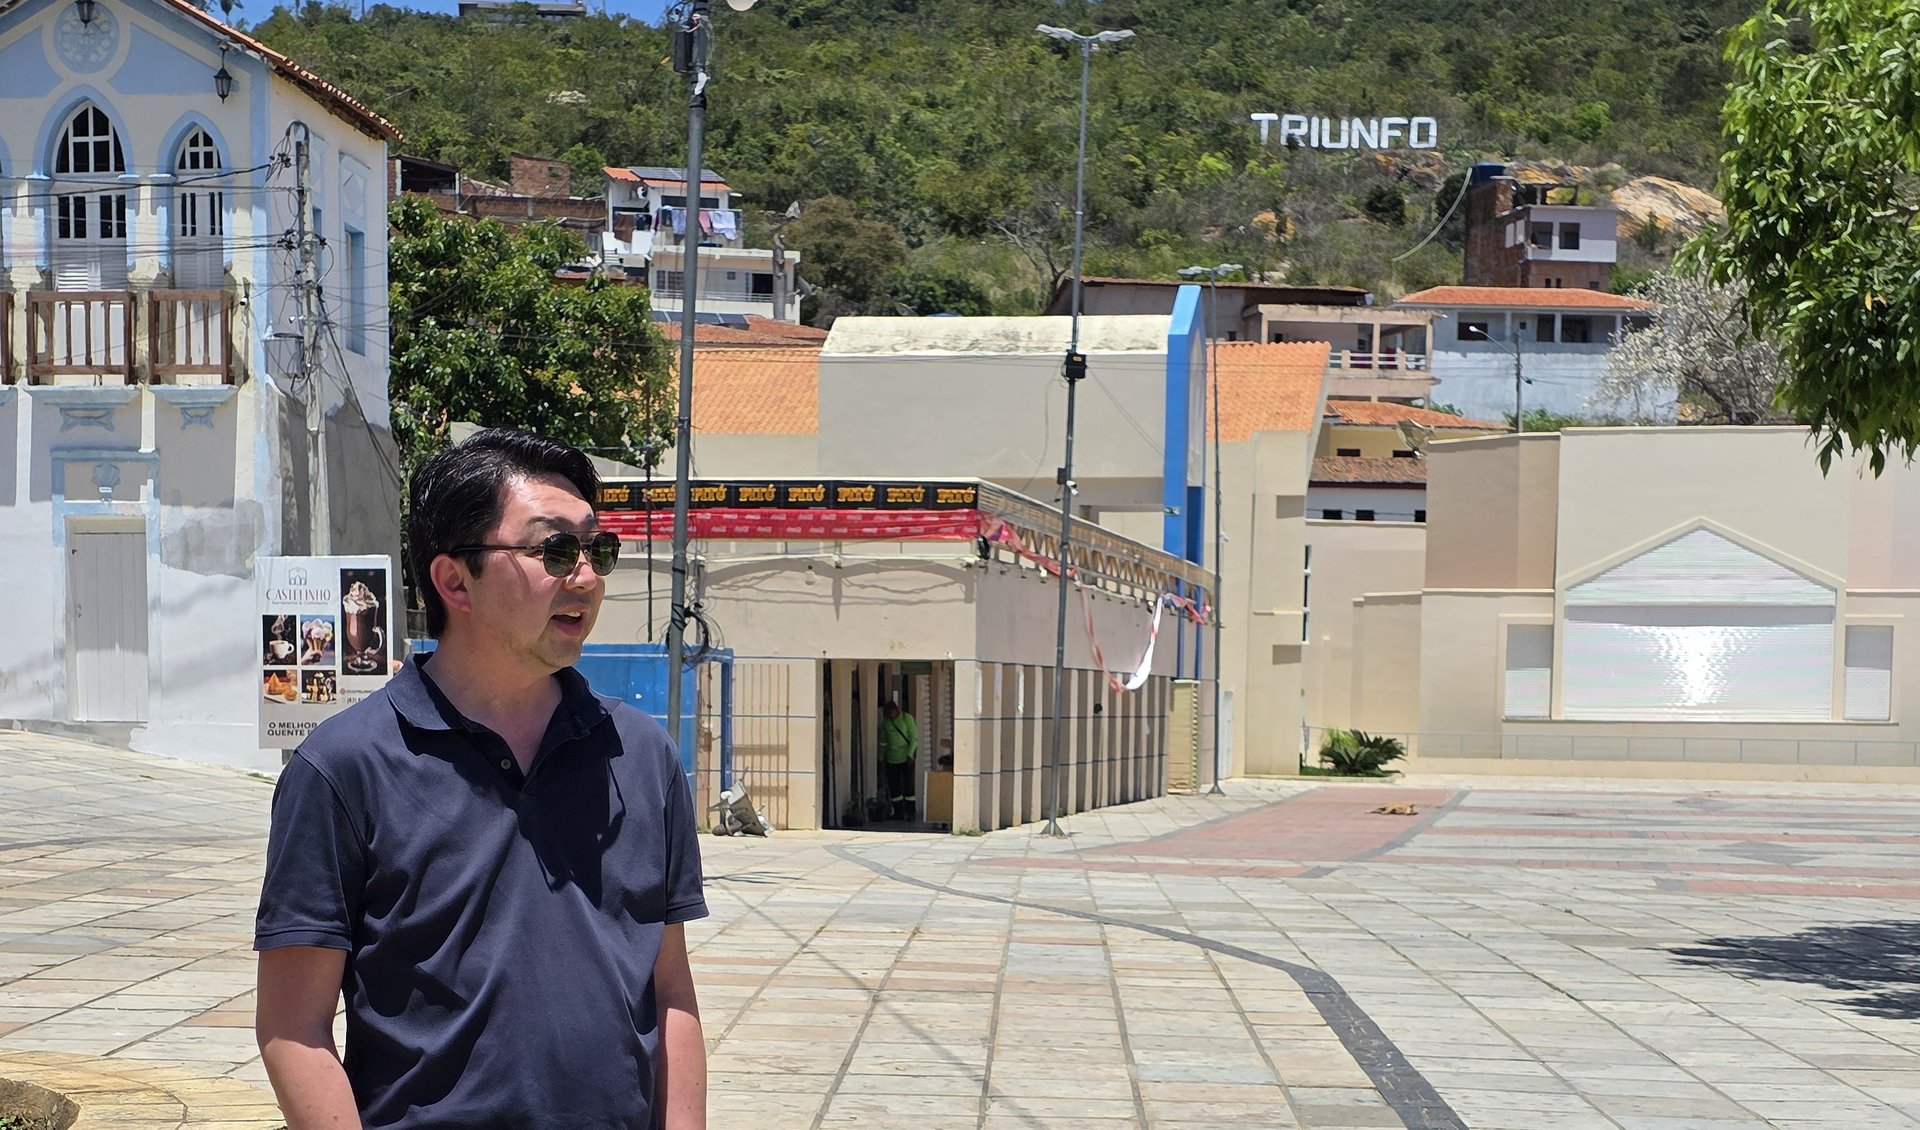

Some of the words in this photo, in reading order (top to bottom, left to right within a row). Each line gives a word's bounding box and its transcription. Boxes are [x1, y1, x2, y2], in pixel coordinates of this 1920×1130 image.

[1250, 113, 1438, 149] TRIUNFO
[690, 484, 728, 502] PITÚ
[739, 484, 776, 502] PITÚ
[788, 484, 825, 502] PITÚ
[837, 485, 875, 502] PITÚ
[886, 485, 925, 503] PITÚ
[936, 486, 976, 504] PITÚ
[265, 588, 331, 601] CASTELINHO
